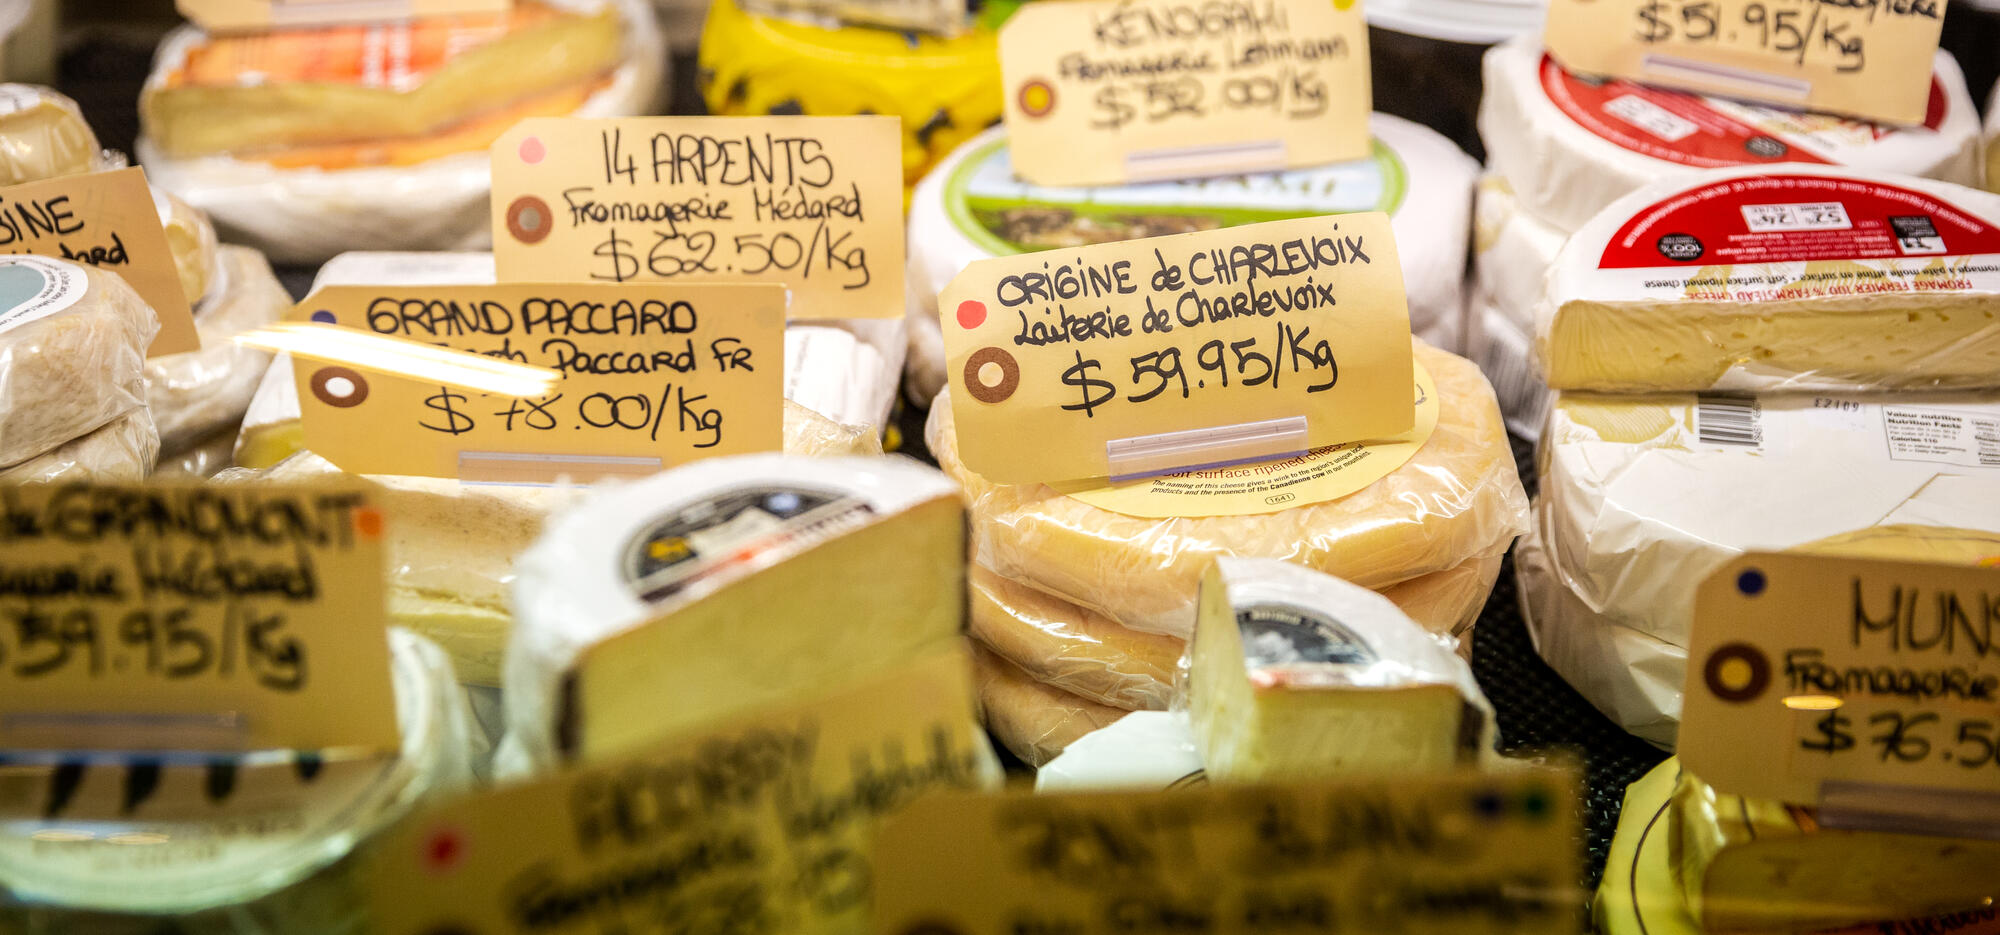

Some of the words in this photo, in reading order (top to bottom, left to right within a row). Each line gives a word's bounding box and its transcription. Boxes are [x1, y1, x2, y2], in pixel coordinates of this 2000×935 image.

[602, 128, 638, 185] 14
[651, 133, 834, 188] ARPENTS
[562, 187, 733, 236] Fromagerie
[753, 183, 864, 223] Médard
[1152, 249, 1186, 292] de
[1800, 271, 1837, 283] surface
[1840, 271, 1854, 280] en
[1889, 269, 1920, 279] molle
[1923, 265, 1946, 278] pâte
[1958, 263, 2000, 274] romage
[1643, 280, 1680, 290] cheese
[1683, 278, 1724, 289] ripened
[1726, 276, 1765, 287] surface
[1767, 275, 1789, 286] Soft
[1855, 281, 1909, 295] FERMIER
[1913, 279, 1973, 291] FROMAGE
[1736, 287, 1810, 301] FARMSTEAD
[366, 297, 514, 336] GRAND
[521, 298, 697, 337] PACCARD
[1013, 306, 1134, 346] Laiterie
[1141, 299, 1172, 335] de
[1175, 275, 1337, 328] Charlevoix
[541, 337, 697, 380] Paccard
[1195, 468, 1252, 479] surface
[1254, 455, 1307, 476] ripened
[1150, 487, 1183, 496] products
[1184, 488, 1199, 496] and
[1200, 488, 1213, 496] the
[1213, 488, 1247, 497] presence
[1247, 486, 1256, 494] of
[1256, 485, 1269, 493] the
[1270, 476, 1312, 491] Canadienne
[1312, 471, 1326, 480] cow
[1326, 468, 1334, 476] in
[1166, 481, 1194, 490] naming
[1195, 482, 1205, 490] of
[1204, 482, 1219, 490] this
[1220, 482, 1245, 490] cheese
[1246, 479, 1266, 489] gives
[1273, 473, 1290, 483] wink
[1290, 471, 1299, 479] to
[1298, 468, 1310, 477] the
[1851, 576, 2000, 657] MUN
[0, 600, 308, 694] 59.95/Kg
[1799, 709, 2000, 771] $76.5
